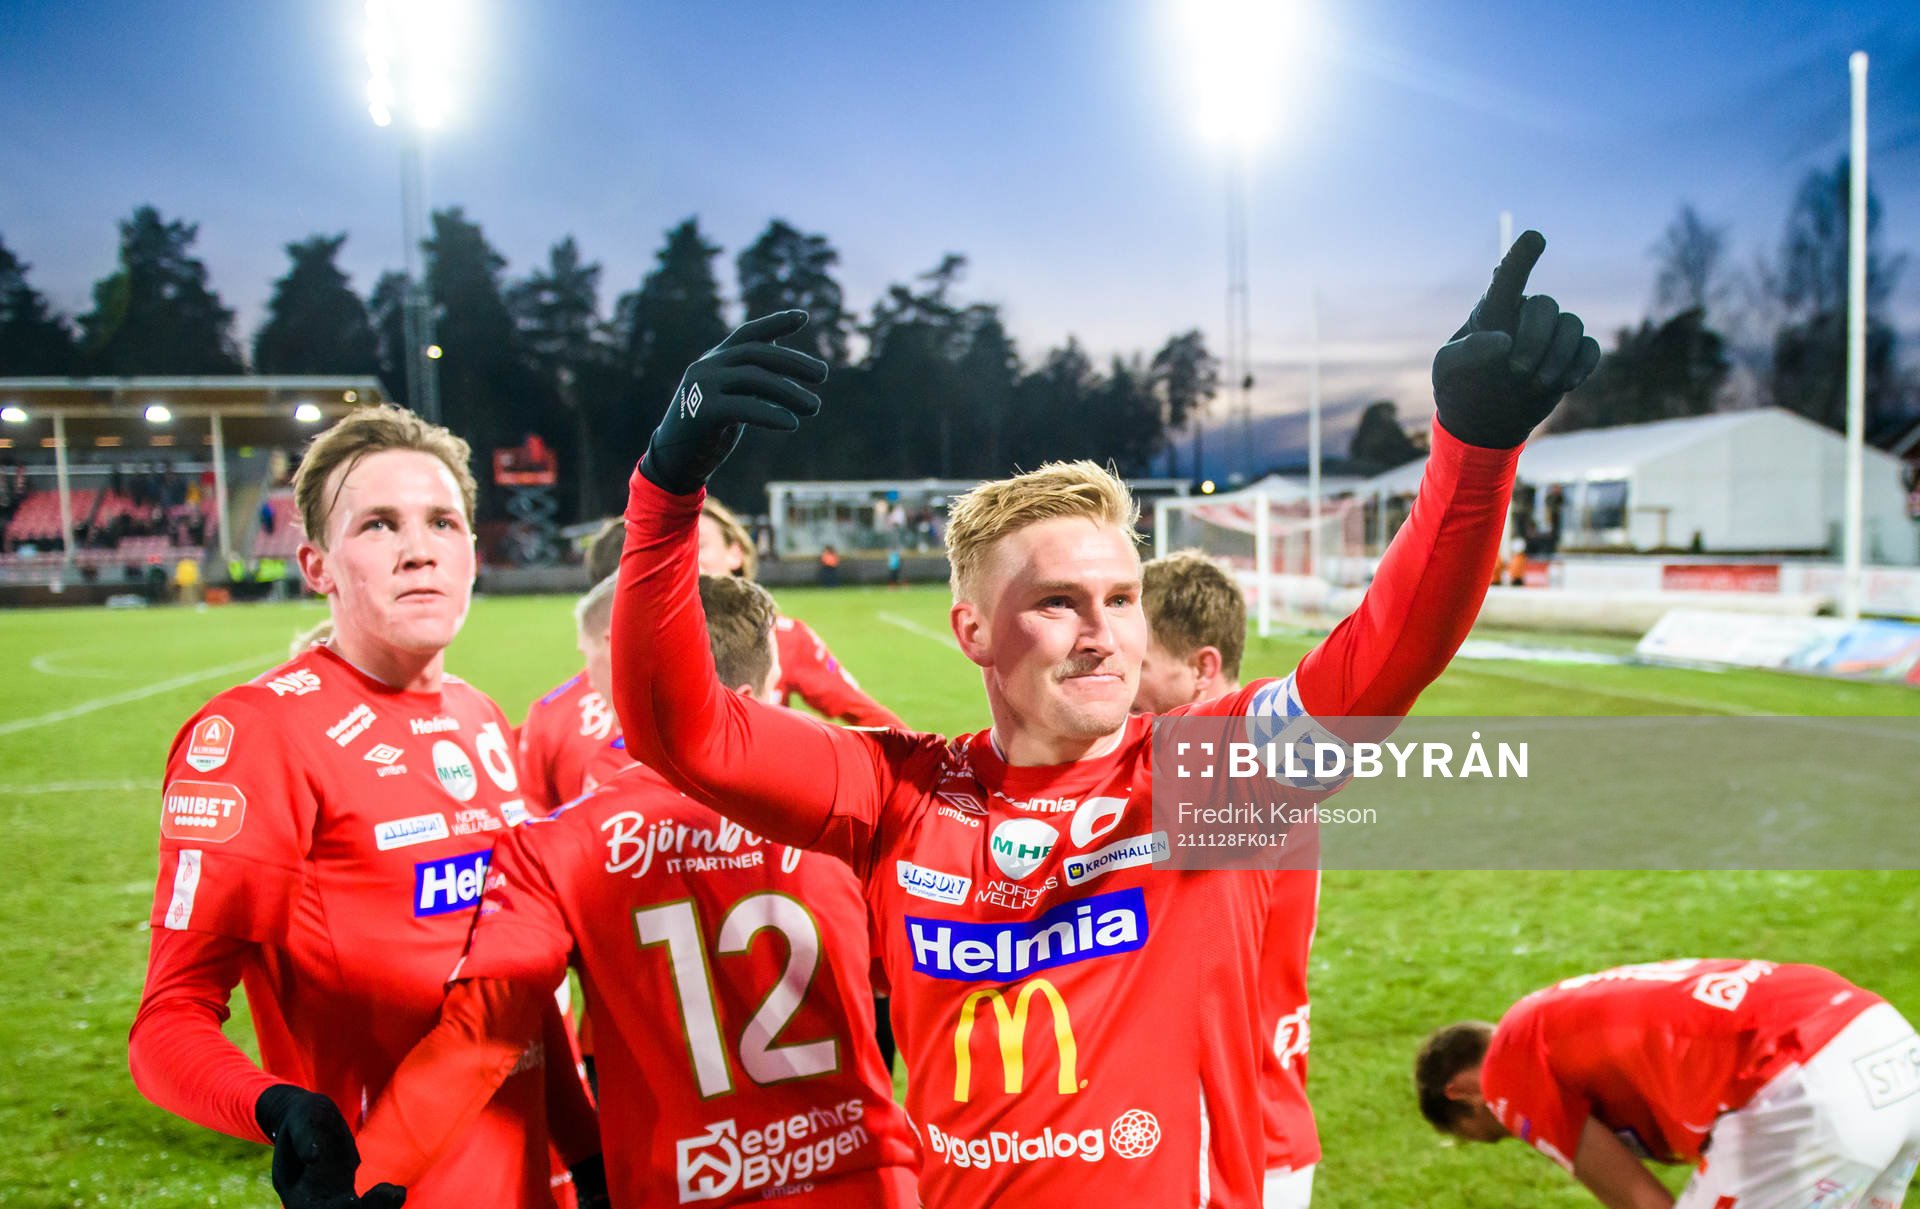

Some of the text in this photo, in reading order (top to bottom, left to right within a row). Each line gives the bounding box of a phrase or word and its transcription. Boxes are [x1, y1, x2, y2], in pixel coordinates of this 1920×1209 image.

[437, 765, 473, 784] MHE
[168, 796, 236, 817] UNIBET
[937, 807, 979, 828] umbro
[1086, 841, 1167, 873] KRONHALLEN
[420, 857, 487, 909] Hel
[910, 904, 1139, 974] Helmia
[630, 889, 841, 1101] 12
[742, 1124, 868, 1190] Byggen
[927, 1124, 1105, 1169] ByggDialog
[761, 1182, 814, 1200] umbro
